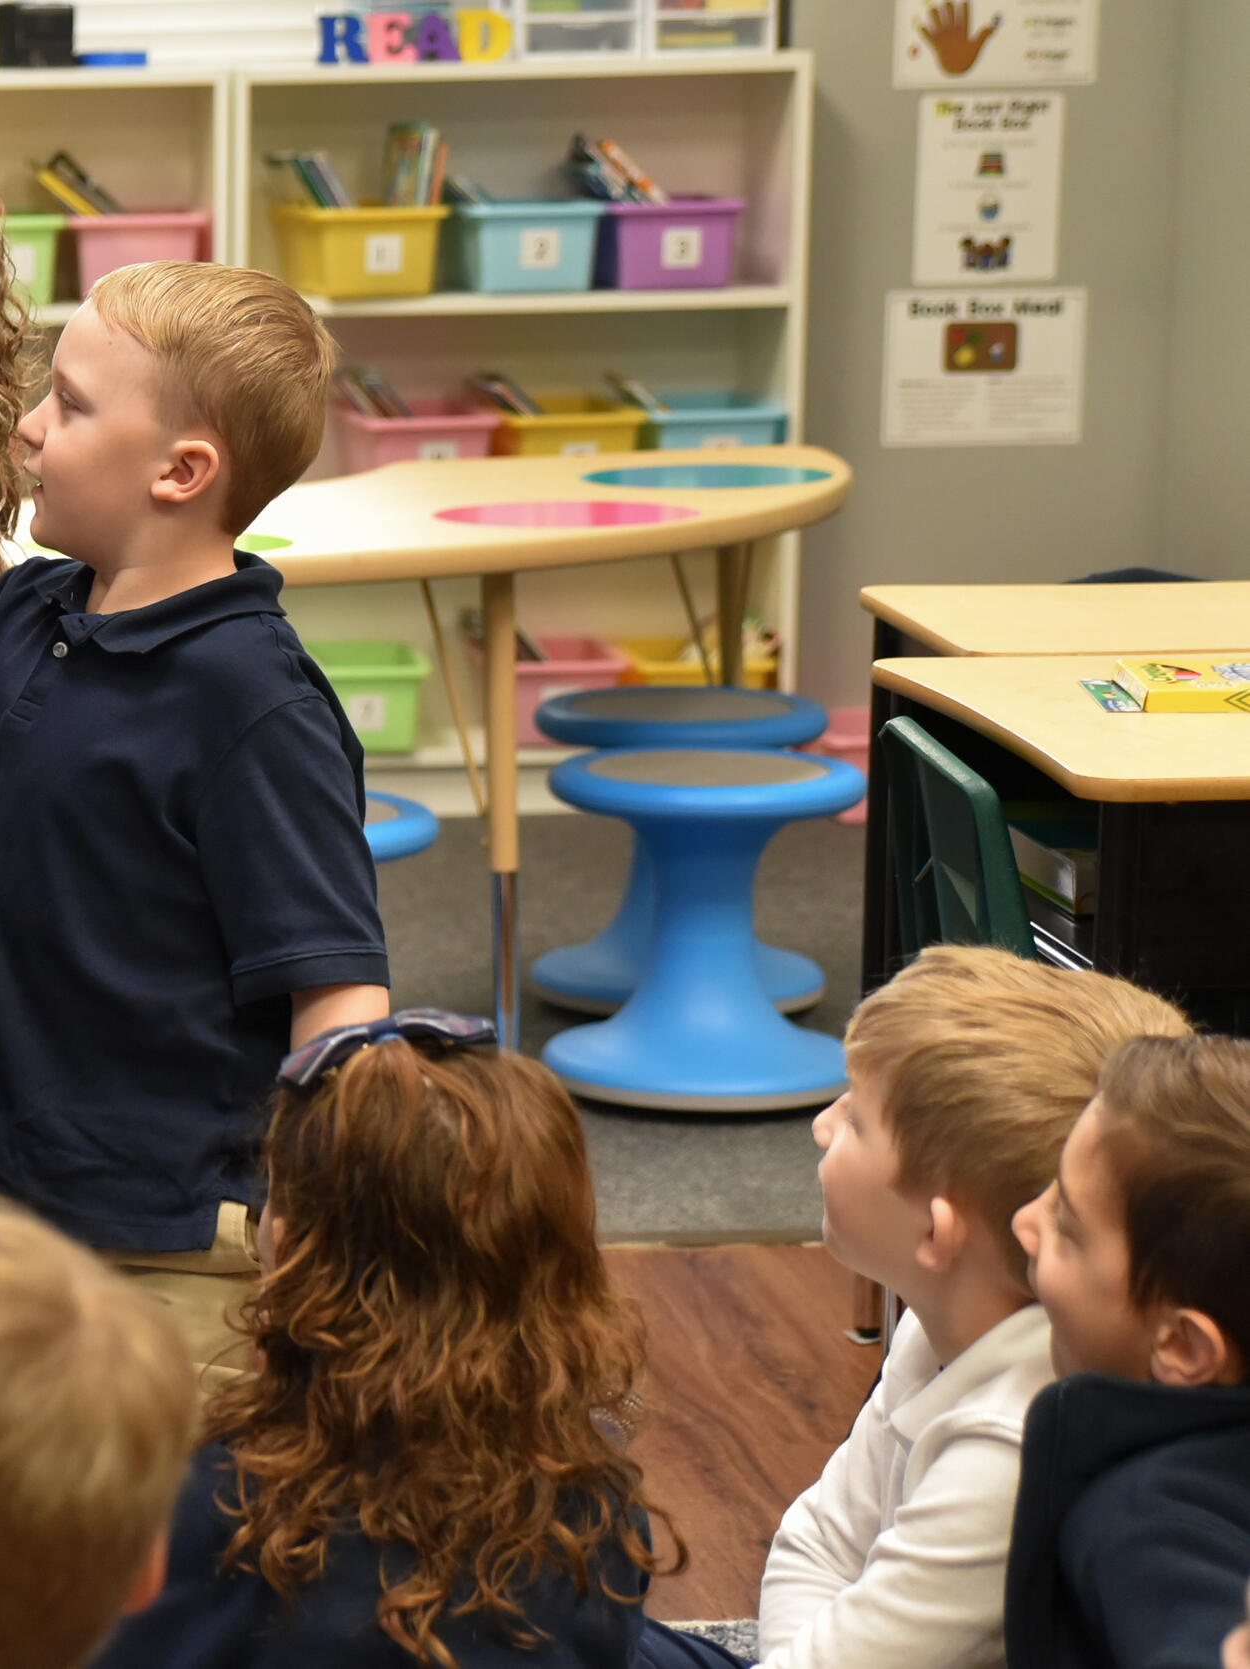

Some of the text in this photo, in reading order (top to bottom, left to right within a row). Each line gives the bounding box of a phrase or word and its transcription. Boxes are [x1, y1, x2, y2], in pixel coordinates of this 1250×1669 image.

[317, 10, 513, 63] READ
[533, 236, 550, 260] 2
[909, 299, 958, 316] Book
[967, 299, 1004, 316] Box
